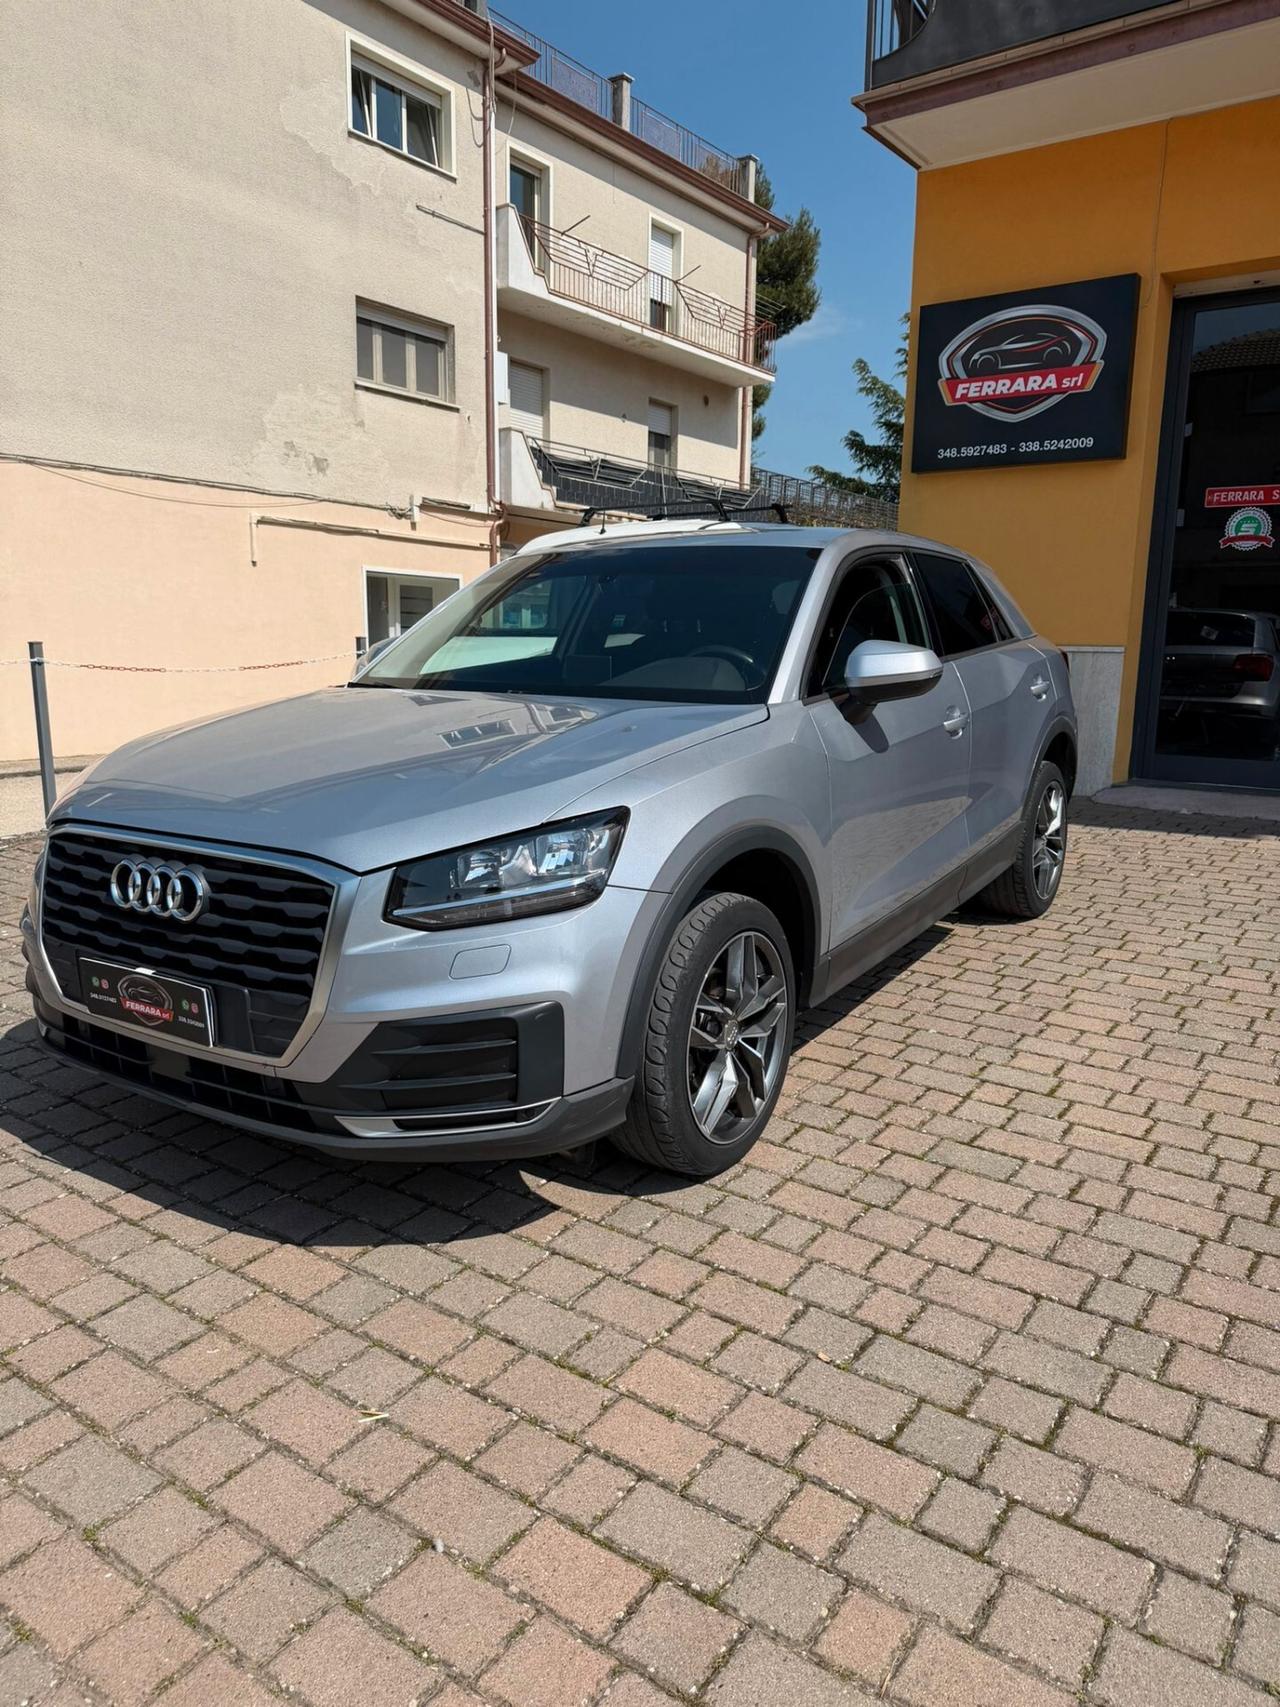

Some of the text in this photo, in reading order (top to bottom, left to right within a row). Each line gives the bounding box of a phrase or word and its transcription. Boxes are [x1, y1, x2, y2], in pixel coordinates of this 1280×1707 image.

[955, 372, 1084, 399] FERRARA srl
[937, 443, 1007, 459] 348.5927483
[1019, 437, 1094, 453] 338.5242009
[1213, 490, 1264, 502] FERRARA
[125, 1001, 162, 1017] FERRARA
